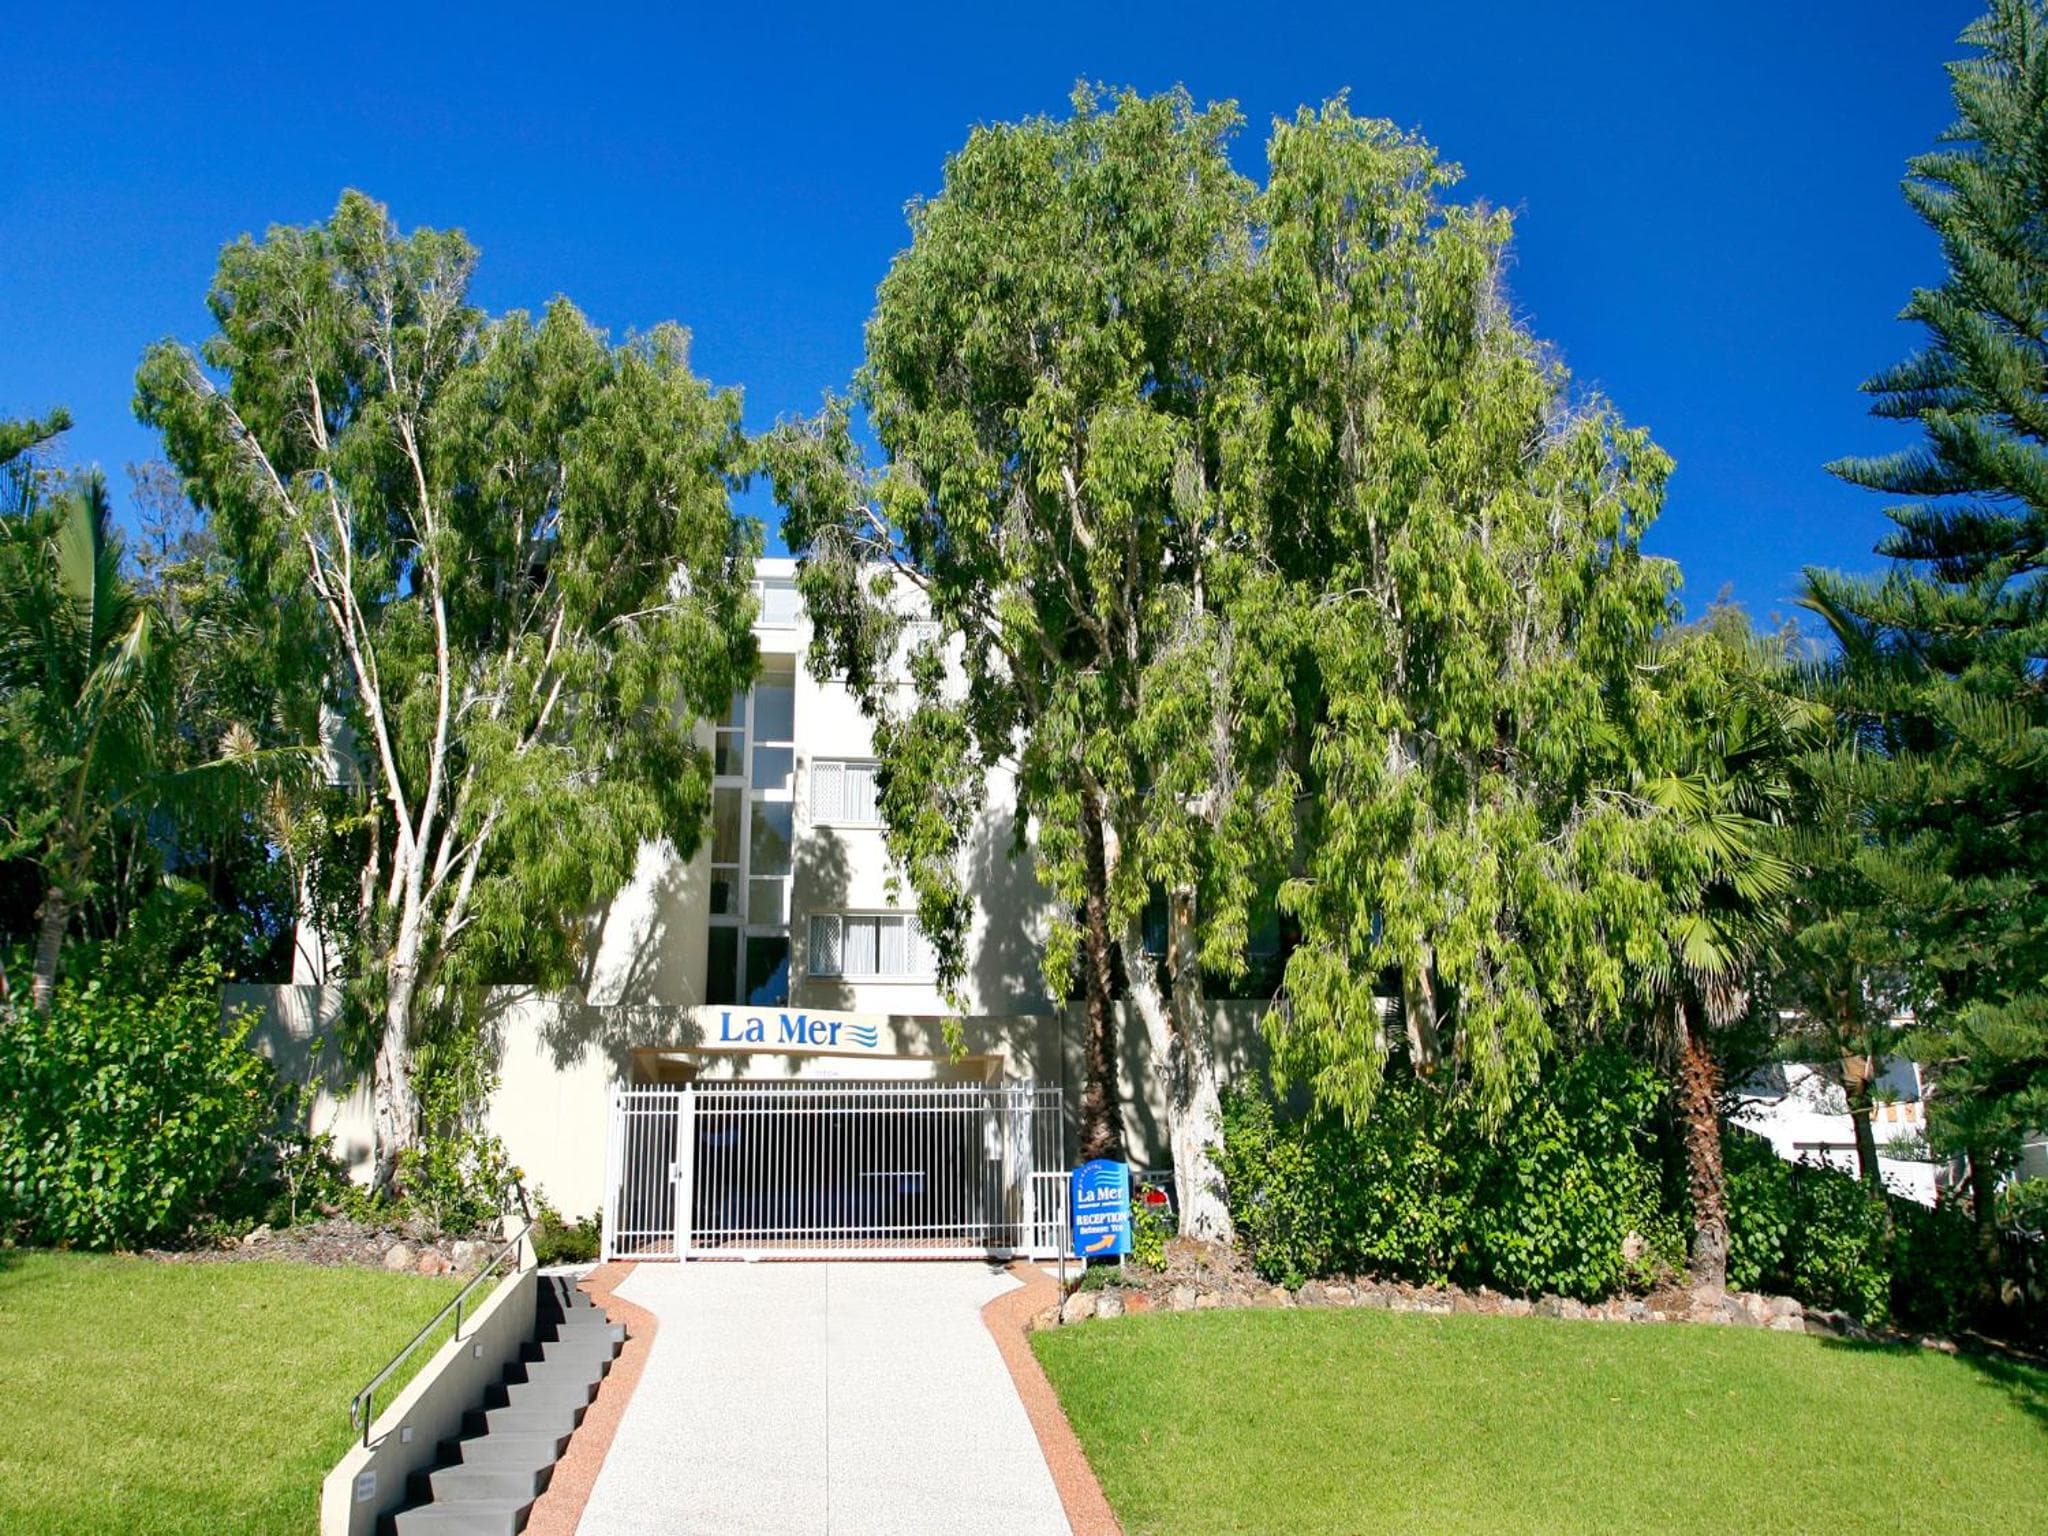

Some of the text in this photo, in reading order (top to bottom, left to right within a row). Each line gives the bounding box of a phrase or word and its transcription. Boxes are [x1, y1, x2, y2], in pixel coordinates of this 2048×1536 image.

[720, 1012, 843, 1046] La Mer
[1078, 1186, 1123, 1203] La Mer
[1077, 1212, 1129, 1226] RECEPTION
